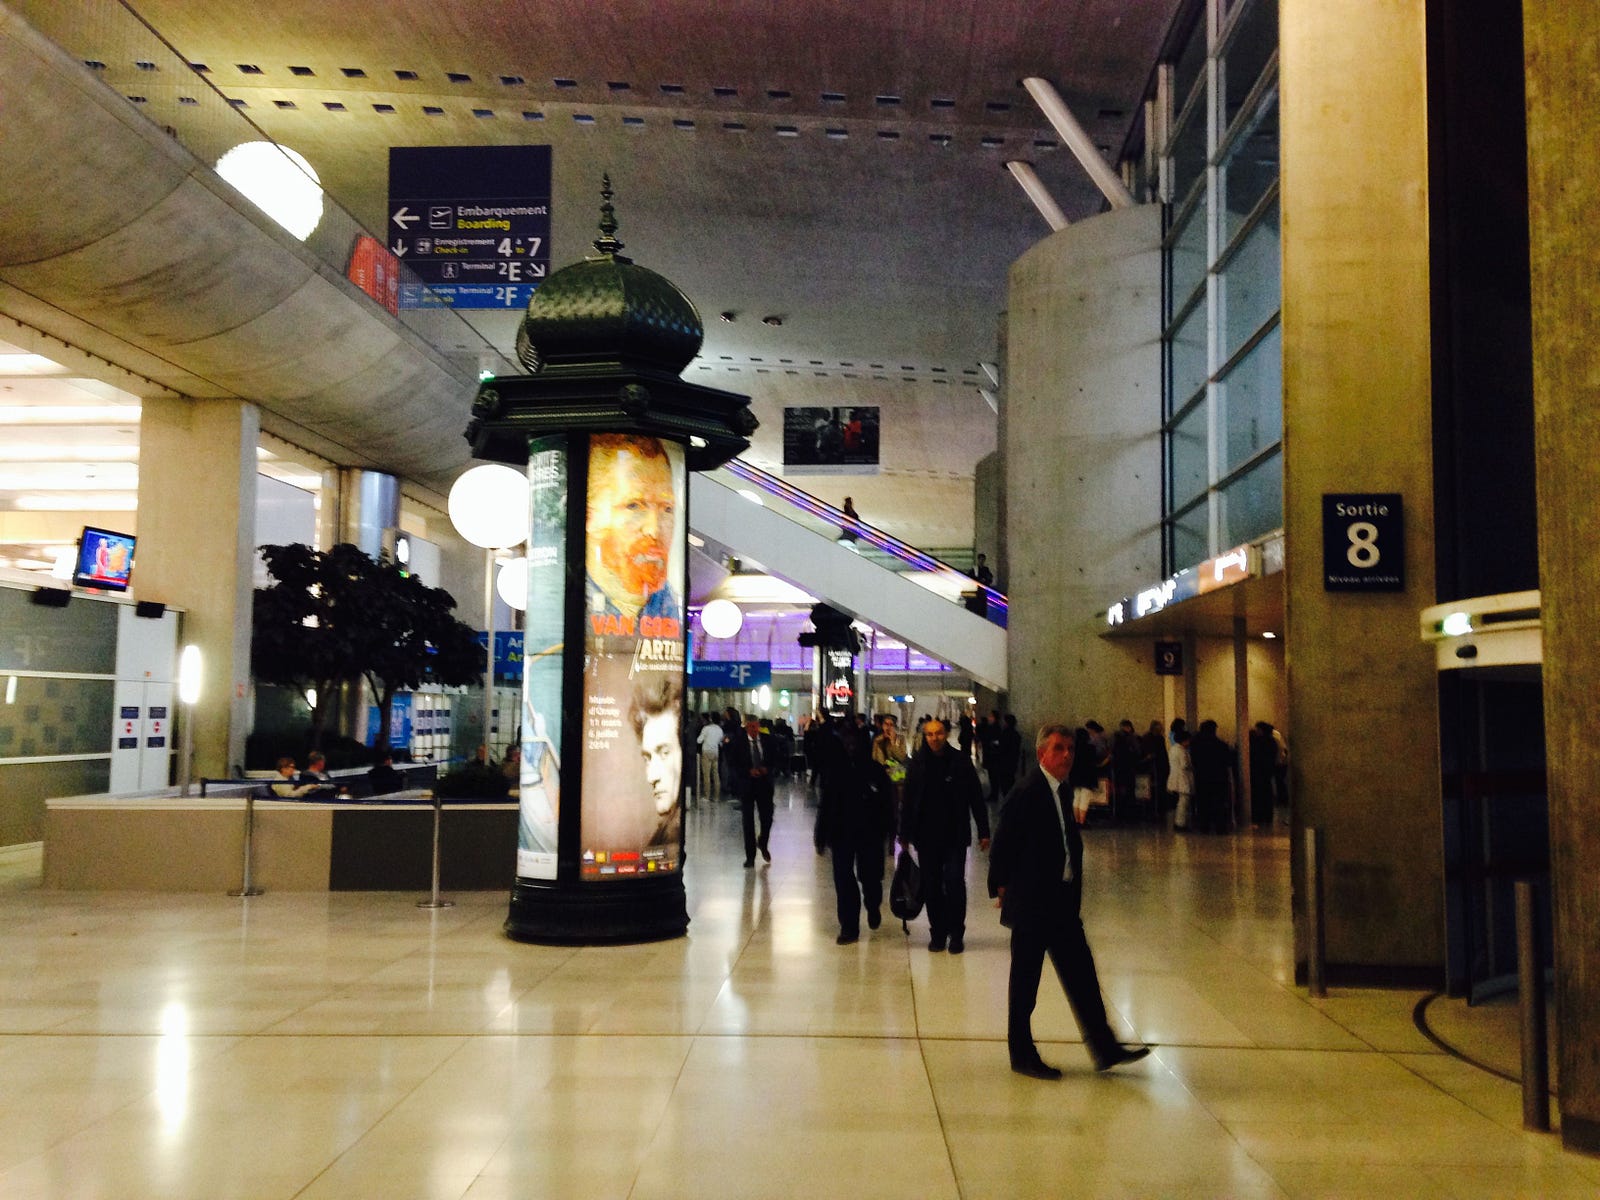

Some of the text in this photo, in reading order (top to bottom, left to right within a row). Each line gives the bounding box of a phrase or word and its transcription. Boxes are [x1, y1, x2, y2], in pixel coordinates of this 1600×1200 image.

[457, 205, 547, 217] Embarquement
[457, 219, 511, 230] Boarding
[497, 237, 513, 258] 4
[528, 237, 541, 257] 7
[461, 262, 522, 281] Terminal 2E
[495, 286, 518, 306] 2F
[1336, 502, 1389, 517] Sortie
[1346, 521, 1380, 569] 8
[590, 613, 635, 636] VAN
[729, 664, 752, 685] 2F
